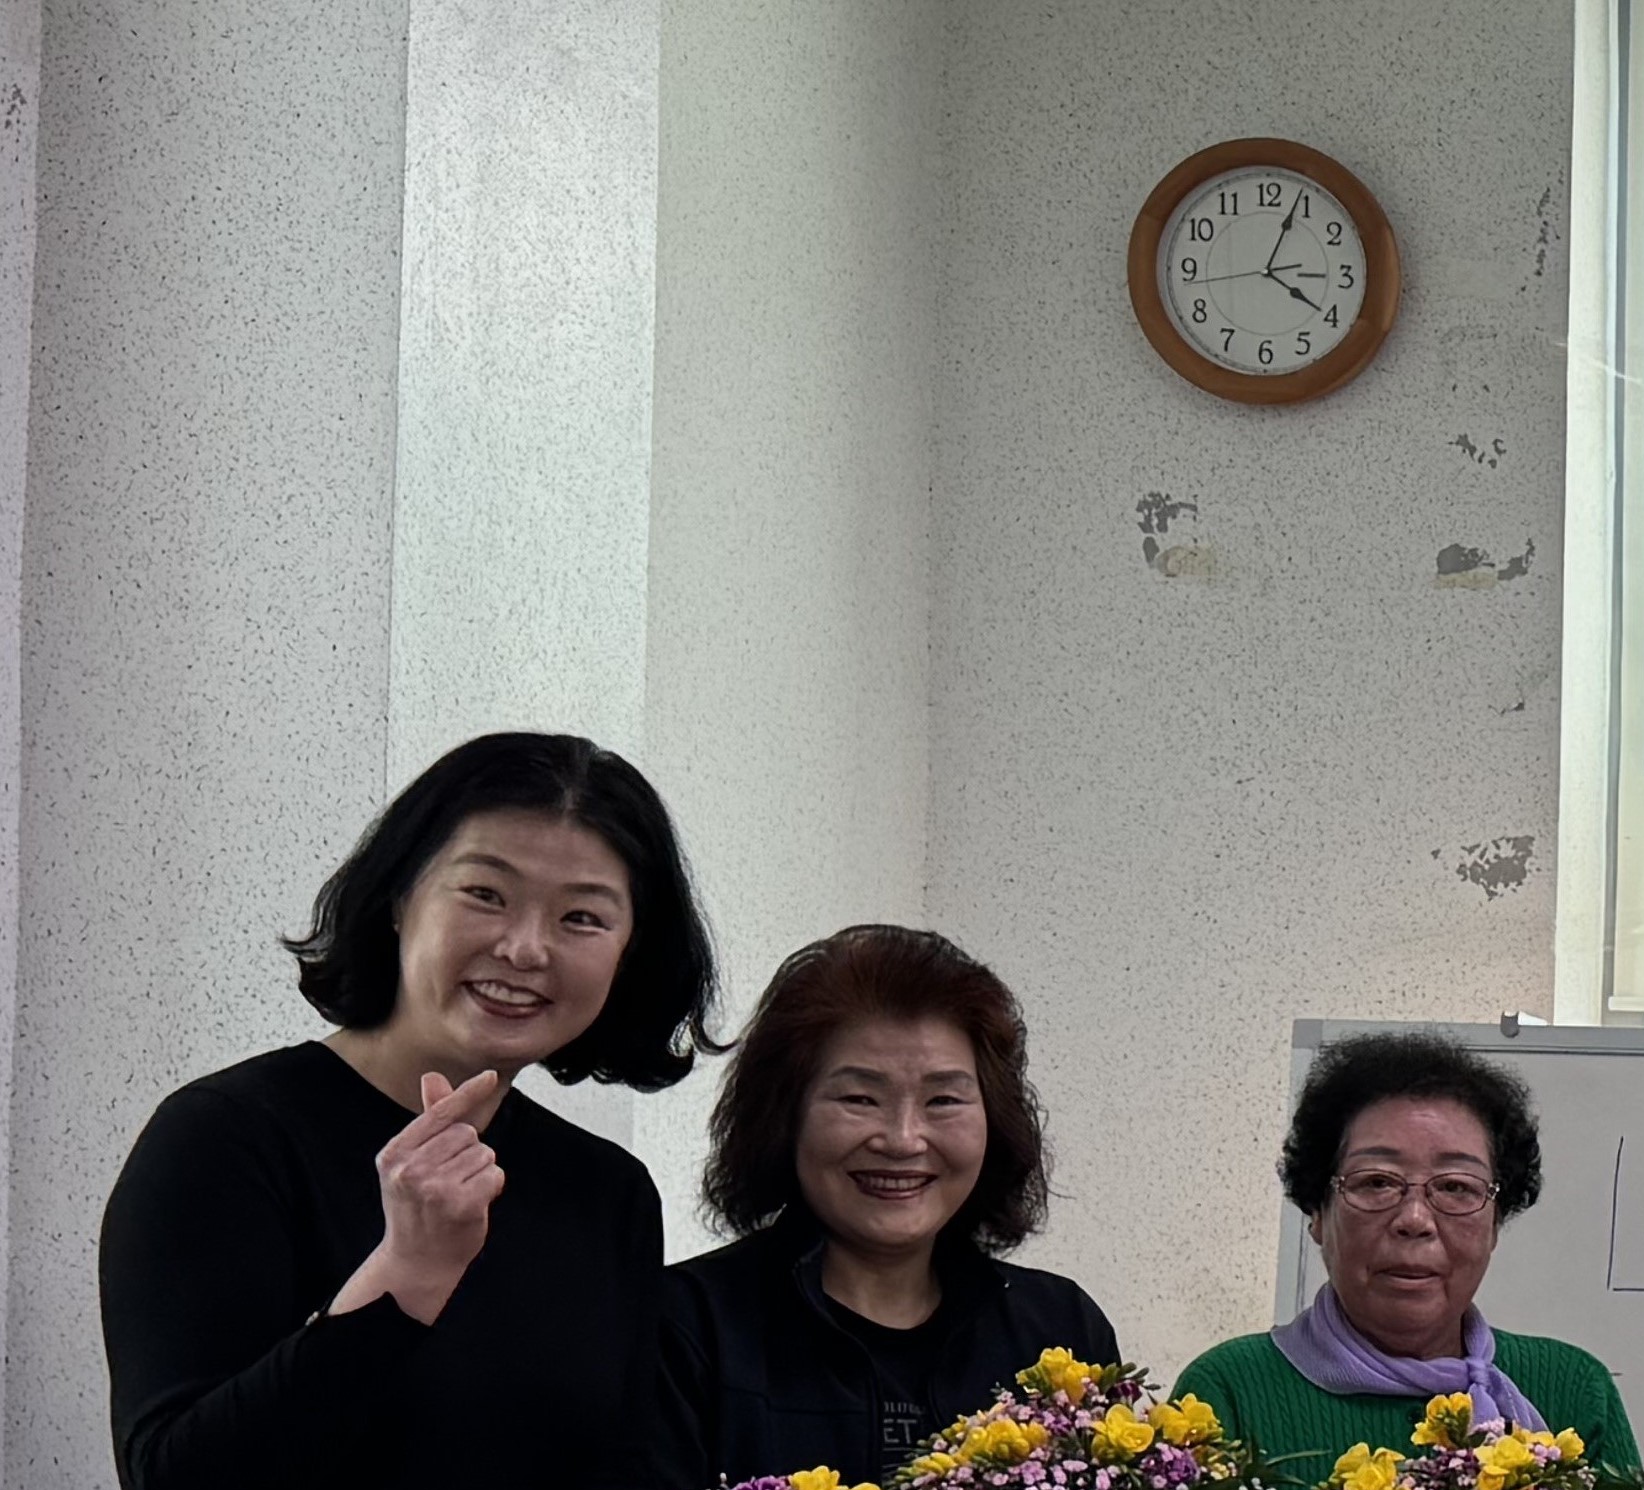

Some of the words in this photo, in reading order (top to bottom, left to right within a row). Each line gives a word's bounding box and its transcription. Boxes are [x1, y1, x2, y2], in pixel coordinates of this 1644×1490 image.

[1218, 191, 1240, 216] 11
[1256, 182, 1282, 207] 12
[1302, 194, 1311, 219] 1
[1188, 217, 1215, 242] 10
[1325, 221, 1343, 246] 2
[1180, 257, 1198, 282] 9
[1337, 264, 1355, 289] 3
[1191, 298, 1208, 324] 8
[1323, 304, 1340, 328] 4
[1219, 327, 1236, 352] 7
[1258, 339, 1274, 365] 6
[1294, 331, 1312, 356] 5
